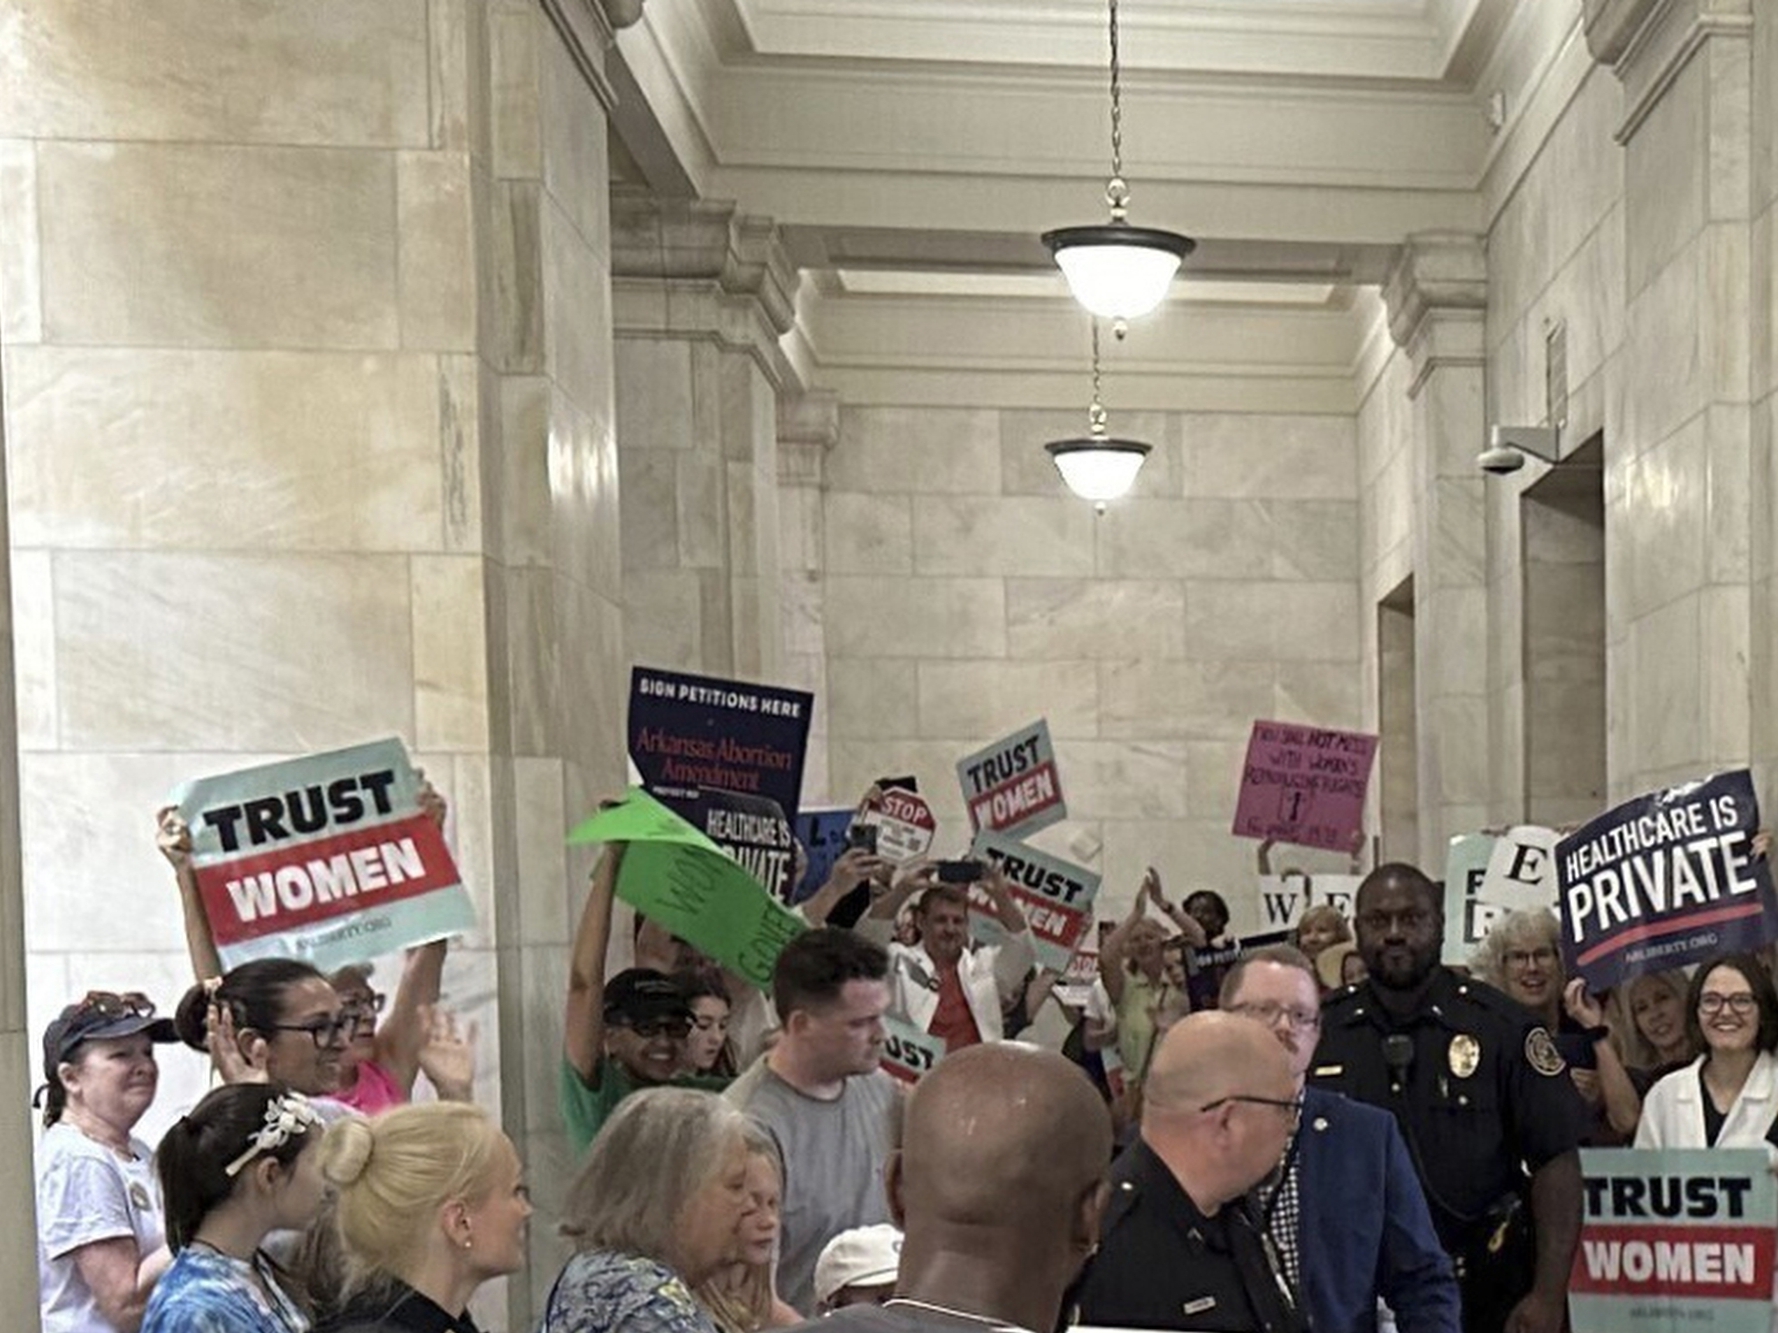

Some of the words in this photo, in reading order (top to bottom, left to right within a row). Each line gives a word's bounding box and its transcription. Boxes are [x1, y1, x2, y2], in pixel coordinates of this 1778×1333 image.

[640, 678, 675, 698] SIGN
[679, 685, 757, 712] PETITIONS
[761, 699, 801, 718] HERE
[637, 727, 714, 758] Arkansas
[718, 737, 793, 771] Abortion
[967, 735, 1041, 793] TRUST
[661, 756, 760, 790] Amendment
[203, 769, 395, 852] TRUST
[881, 796, 928, 823] STOP
[973, 767, 1055, 826] WOMEN
[707, 809, 777, 845] HEALTHCARE
[778, 820, 791, 848] IS
[1566, 803, 1707, 884] HEALTHCARE
[1710, 795, 1738, 830] IS
[226, 837, 425, 922] WOMEN
[986, 847, 1083, 902] TRUST
[1568, 831, 1757, 943] PRIVATE
[884, 1037, 934, 1070] UST
[1584, 1176, 1751, 1218] TRUST
[1583, 1240, 1755, 1284] WOMEN
